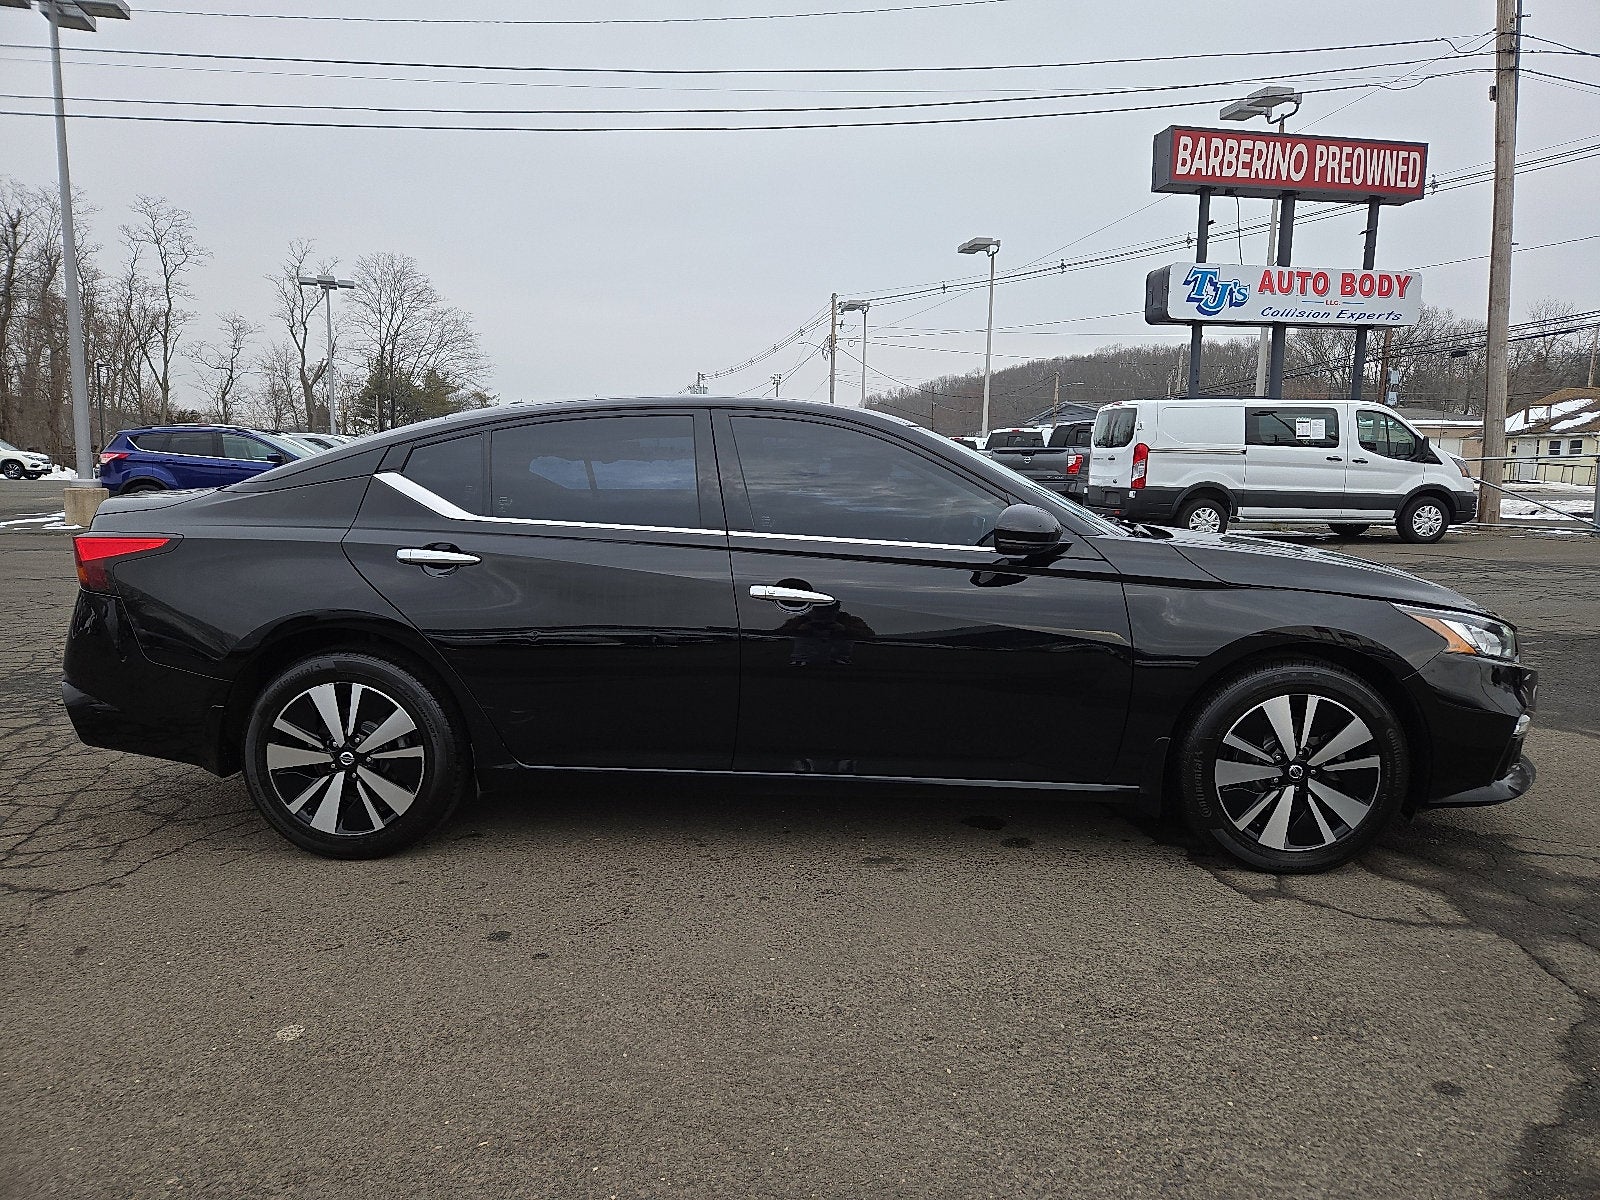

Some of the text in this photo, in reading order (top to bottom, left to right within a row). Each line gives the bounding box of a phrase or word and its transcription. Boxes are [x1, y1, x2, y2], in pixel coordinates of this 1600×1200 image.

[1176, 135, 1421, 188] BARBERINO PREOWNED
[1257, 270, 1413, 299] AUTO BODY
[1260, 306, 1403, 322] Collision Experts
